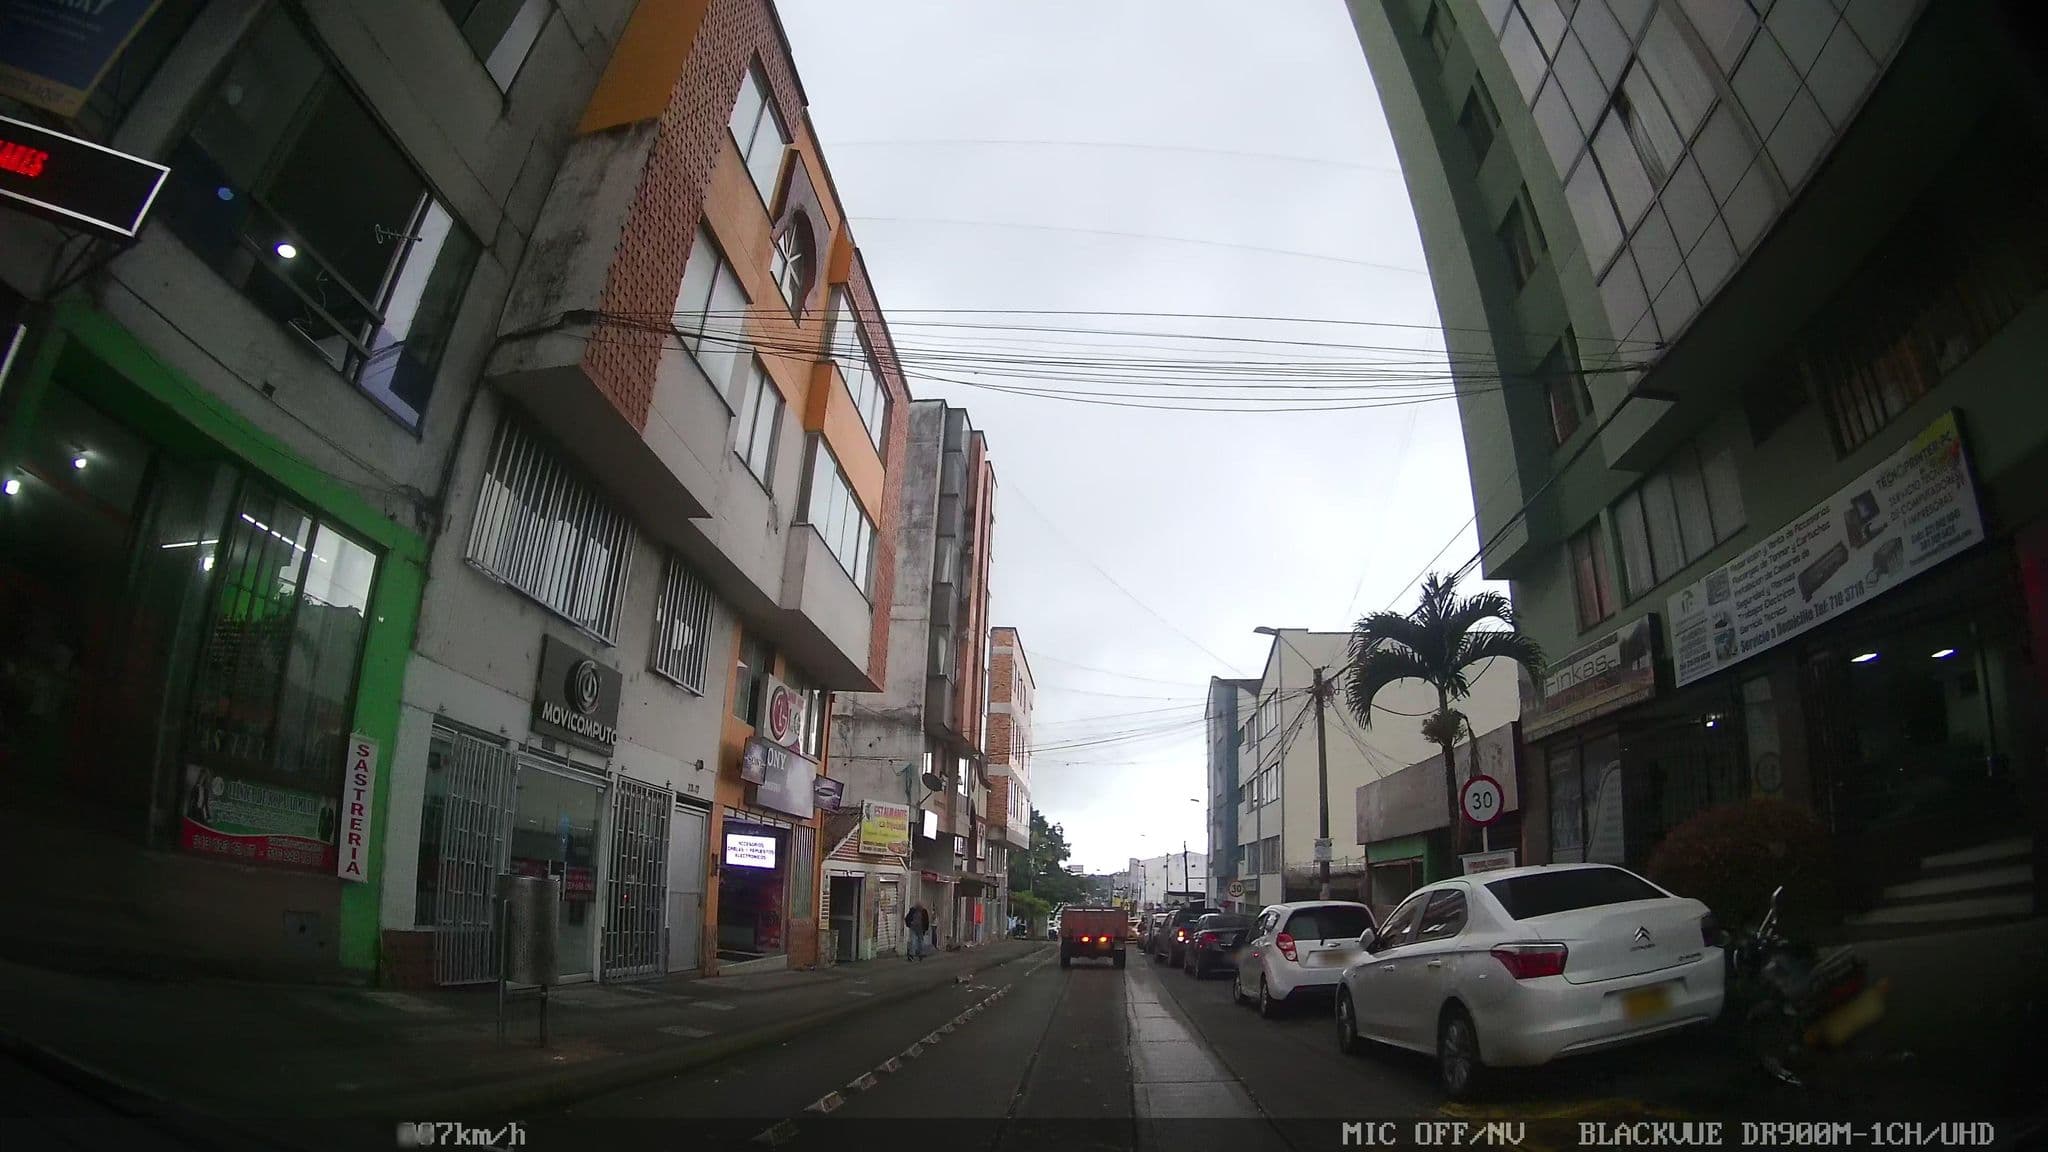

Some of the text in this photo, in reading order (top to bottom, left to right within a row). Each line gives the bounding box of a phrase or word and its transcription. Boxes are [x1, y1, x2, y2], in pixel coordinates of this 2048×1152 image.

[1740, 630, 1770, 653] Servicio
[1776, 606, 1814, 636] Domicilio
[346, 743, 370, 876] SASTRERIA
[1472, 791, 1493, 810] 30
[1231, 884, 1242, 892] 30
